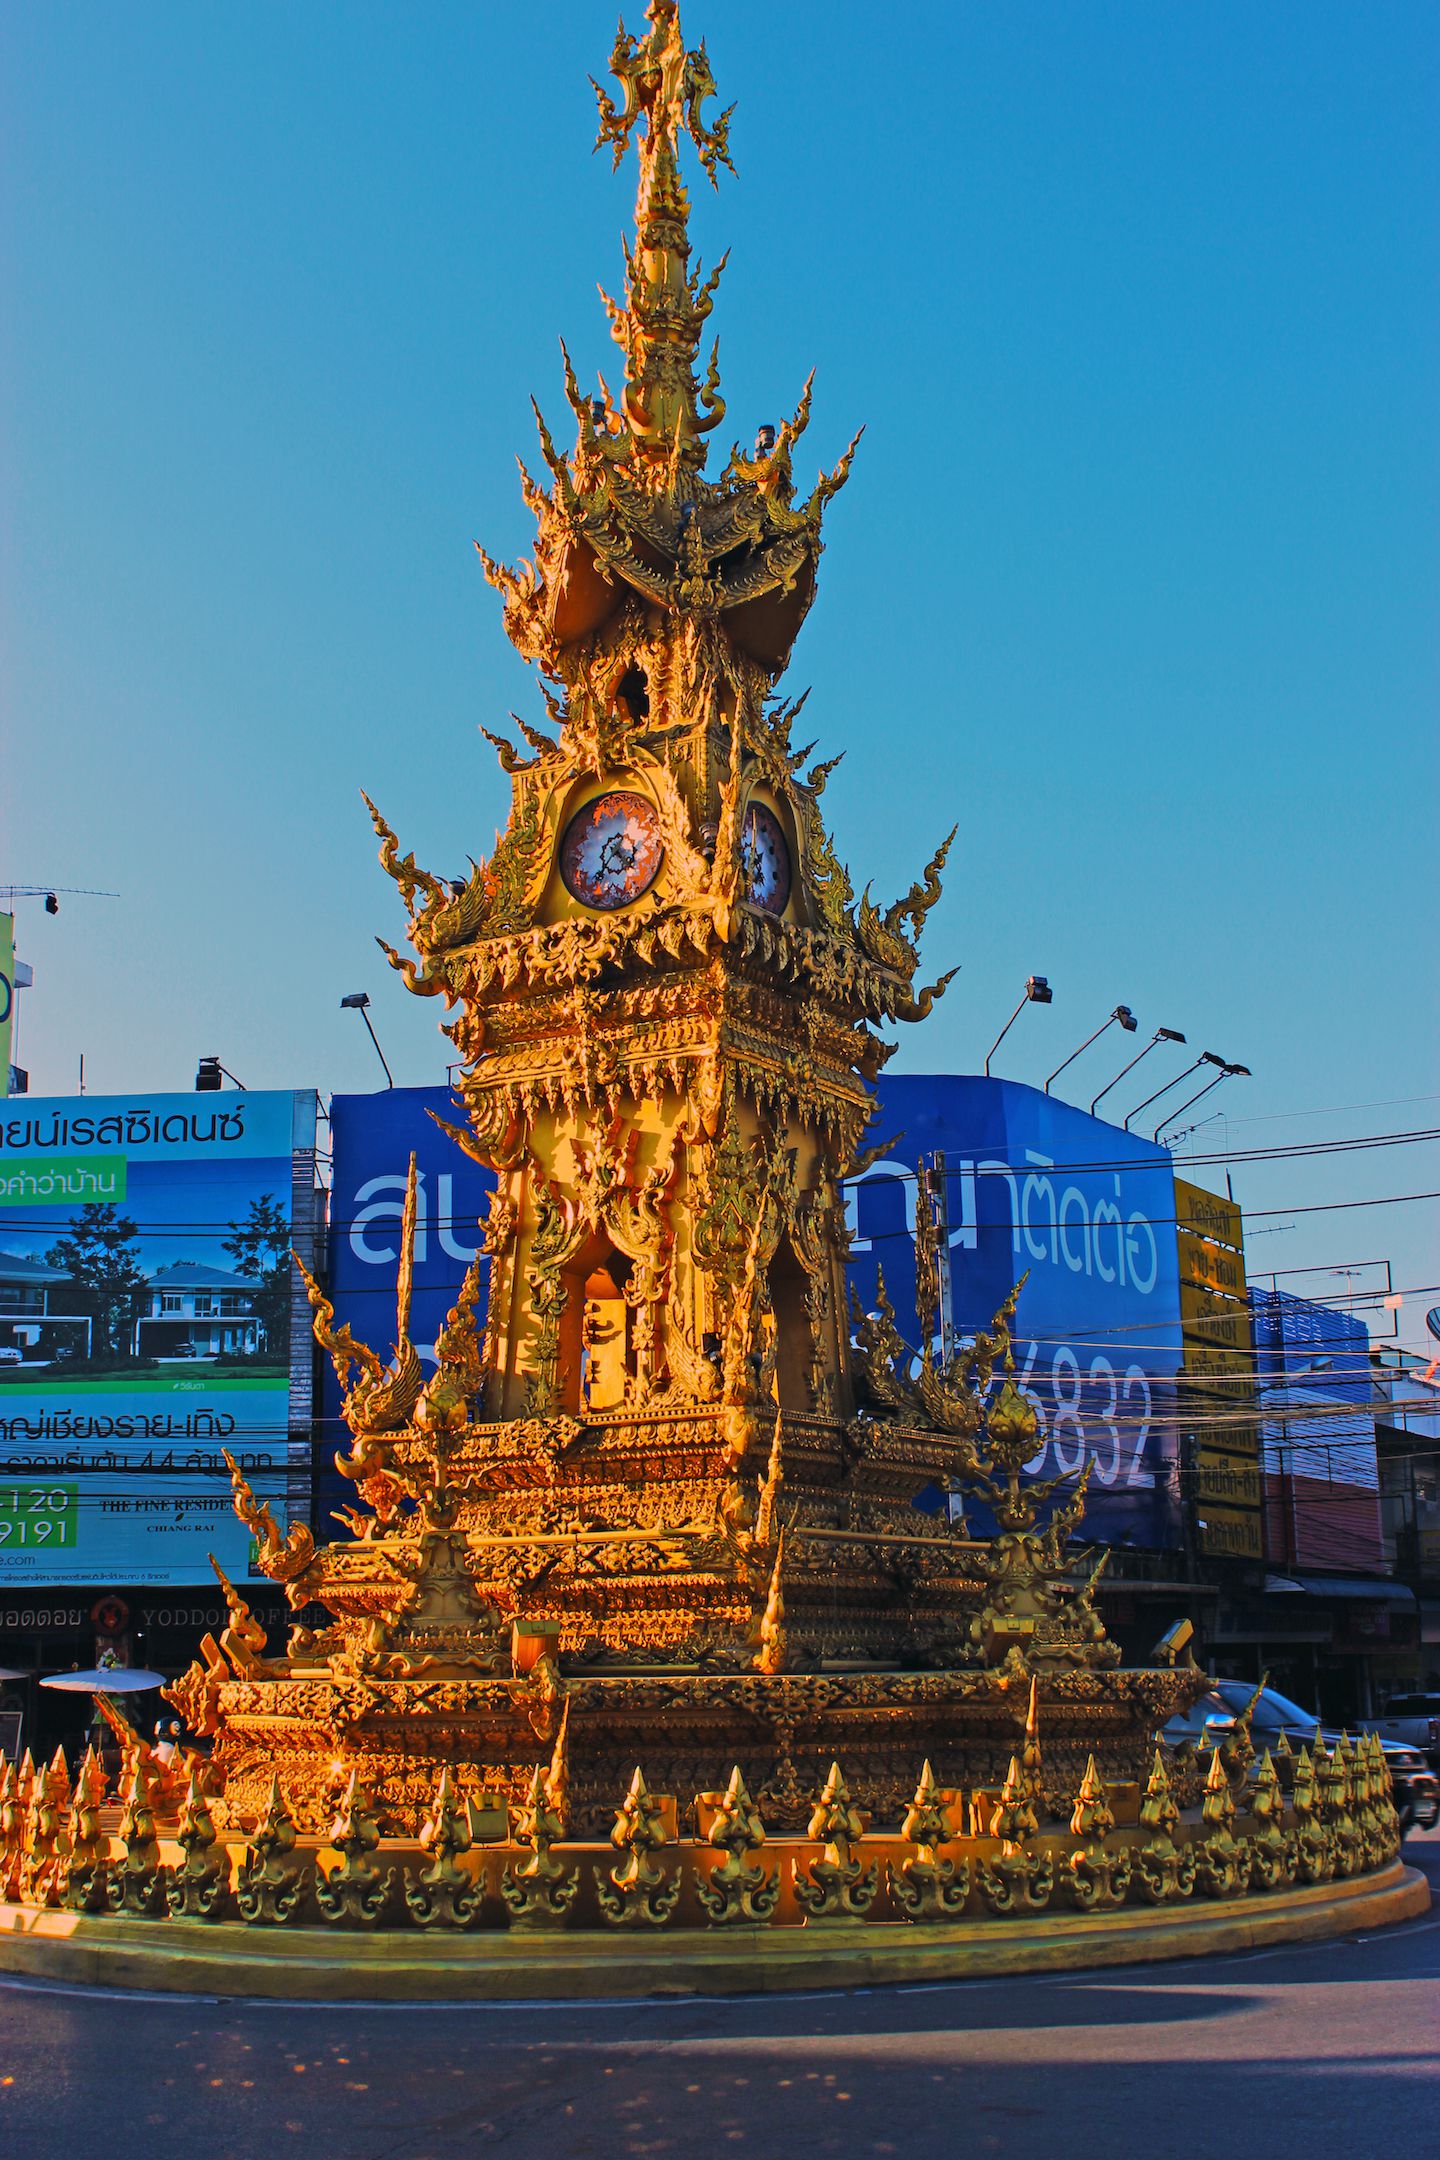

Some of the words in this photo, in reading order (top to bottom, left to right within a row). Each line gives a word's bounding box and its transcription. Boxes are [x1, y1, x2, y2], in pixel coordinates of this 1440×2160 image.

[0, 1105, 245, 1149] ยน์เรสซิเดนซ์
[101, 1500, 131, 1512] THE
[135, 1500, 171, 1512] FINE
[0, 1521, 67, 1544] 9191
[147, 1525, 191, 1533] CHIANG
